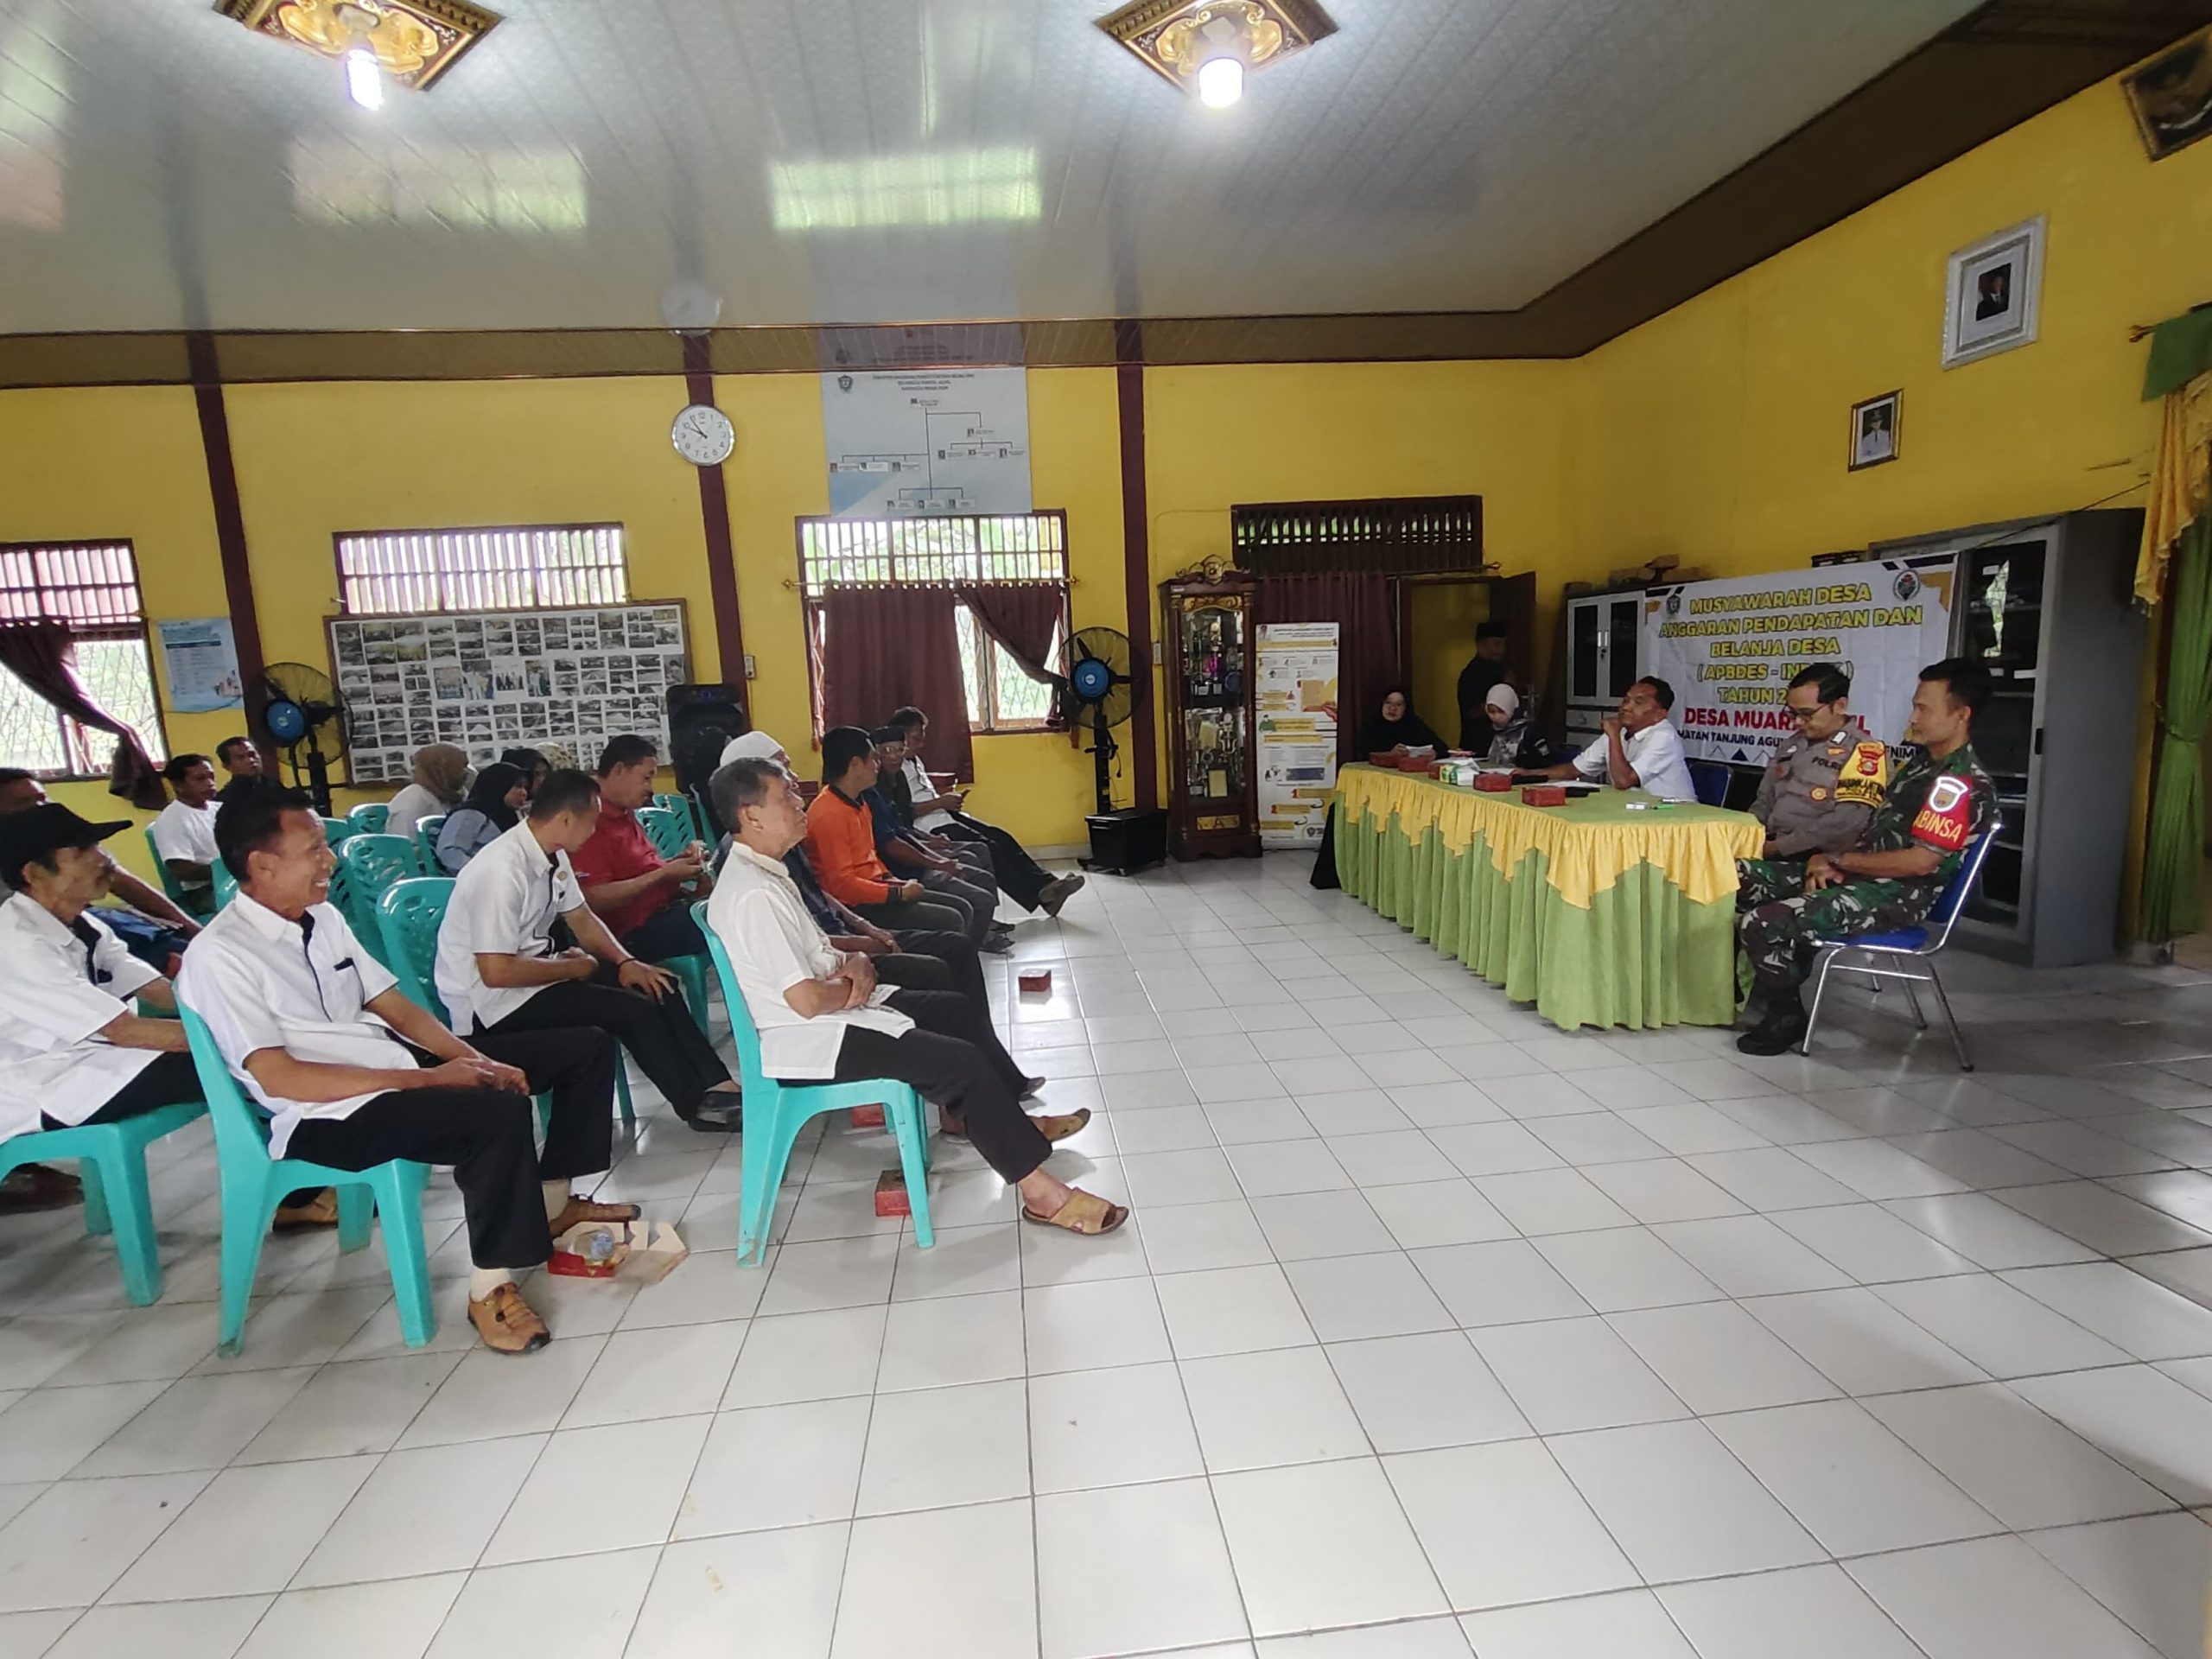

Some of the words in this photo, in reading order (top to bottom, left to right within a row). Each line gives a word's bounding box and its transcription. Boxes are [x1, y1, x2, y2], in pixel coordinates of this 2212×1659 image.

[1690, 588, 1812, 614] MUSYAWARAH
[1815, 582, 1872, 605] DESA
[1659, 618, 1740, 638] ANGGARAN
[1743, 608, 1870, 633] PENDAPATAN
[1873, 606, 1923, 627] DAN
[1710, 639, 1784, 658] BELANJA
[1788, 637, 1841, 656] DESA
[1718, 687, 1773, 705] TAHUN
[1684, 708, 1729, 727] DESA
[1711, 731, 1755, 745] TANJUNG
[1757, 735, 1783, 747] AGU
